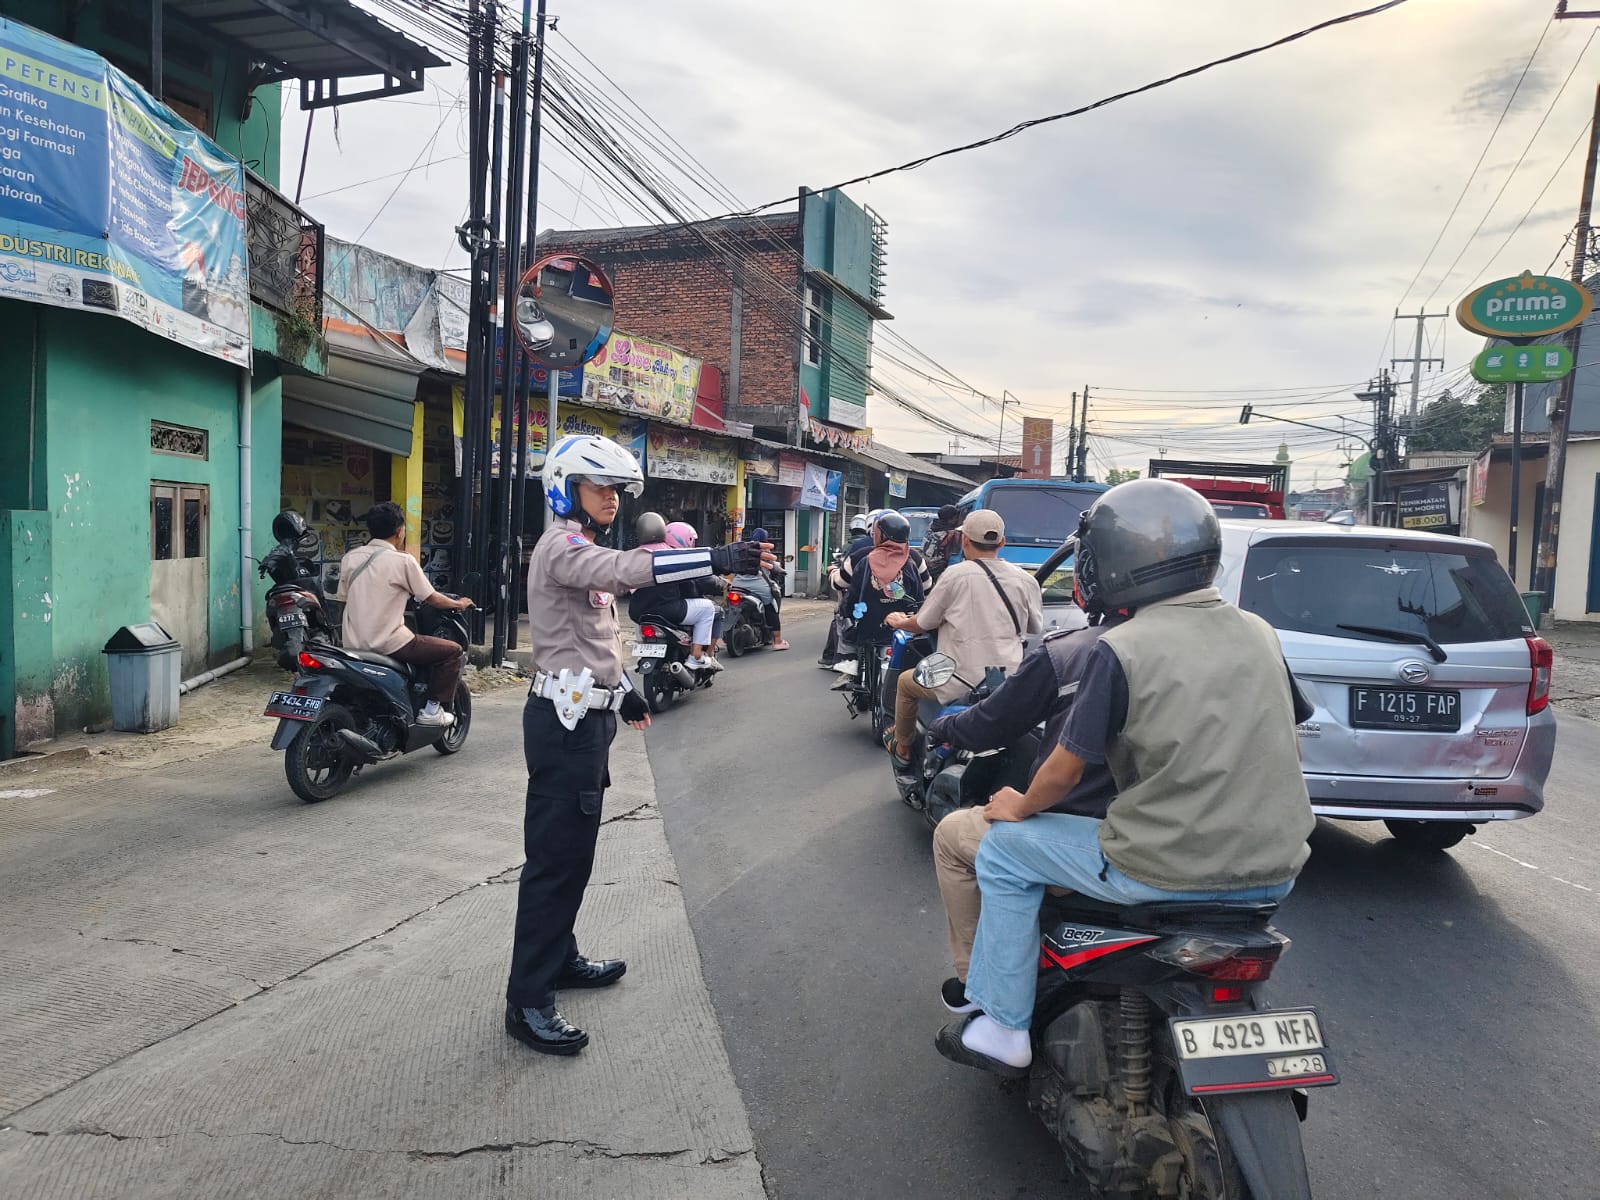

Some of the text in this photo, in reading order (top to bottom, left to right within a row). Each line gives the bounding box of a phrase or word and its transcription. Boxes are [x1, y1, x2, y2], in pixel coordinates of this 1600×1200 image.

[5, 57, 99, 103] PETENSI
[0, 84, 47, 110] Grafika
[15, 108, 86, 141] Kesehatan
[0, 147, 21, 161] ga
[24, 131, 76, 156] Farmasi
[1486, 295, 1567, 317] prima
[1495, 313, 1559, 322] FRESHMART
[611, 339, 651, 371] Love
[1358, 692, 1456, 715] F 1215 FAP
[1181, 1017, 1319, 1054] B 4929 NFA
